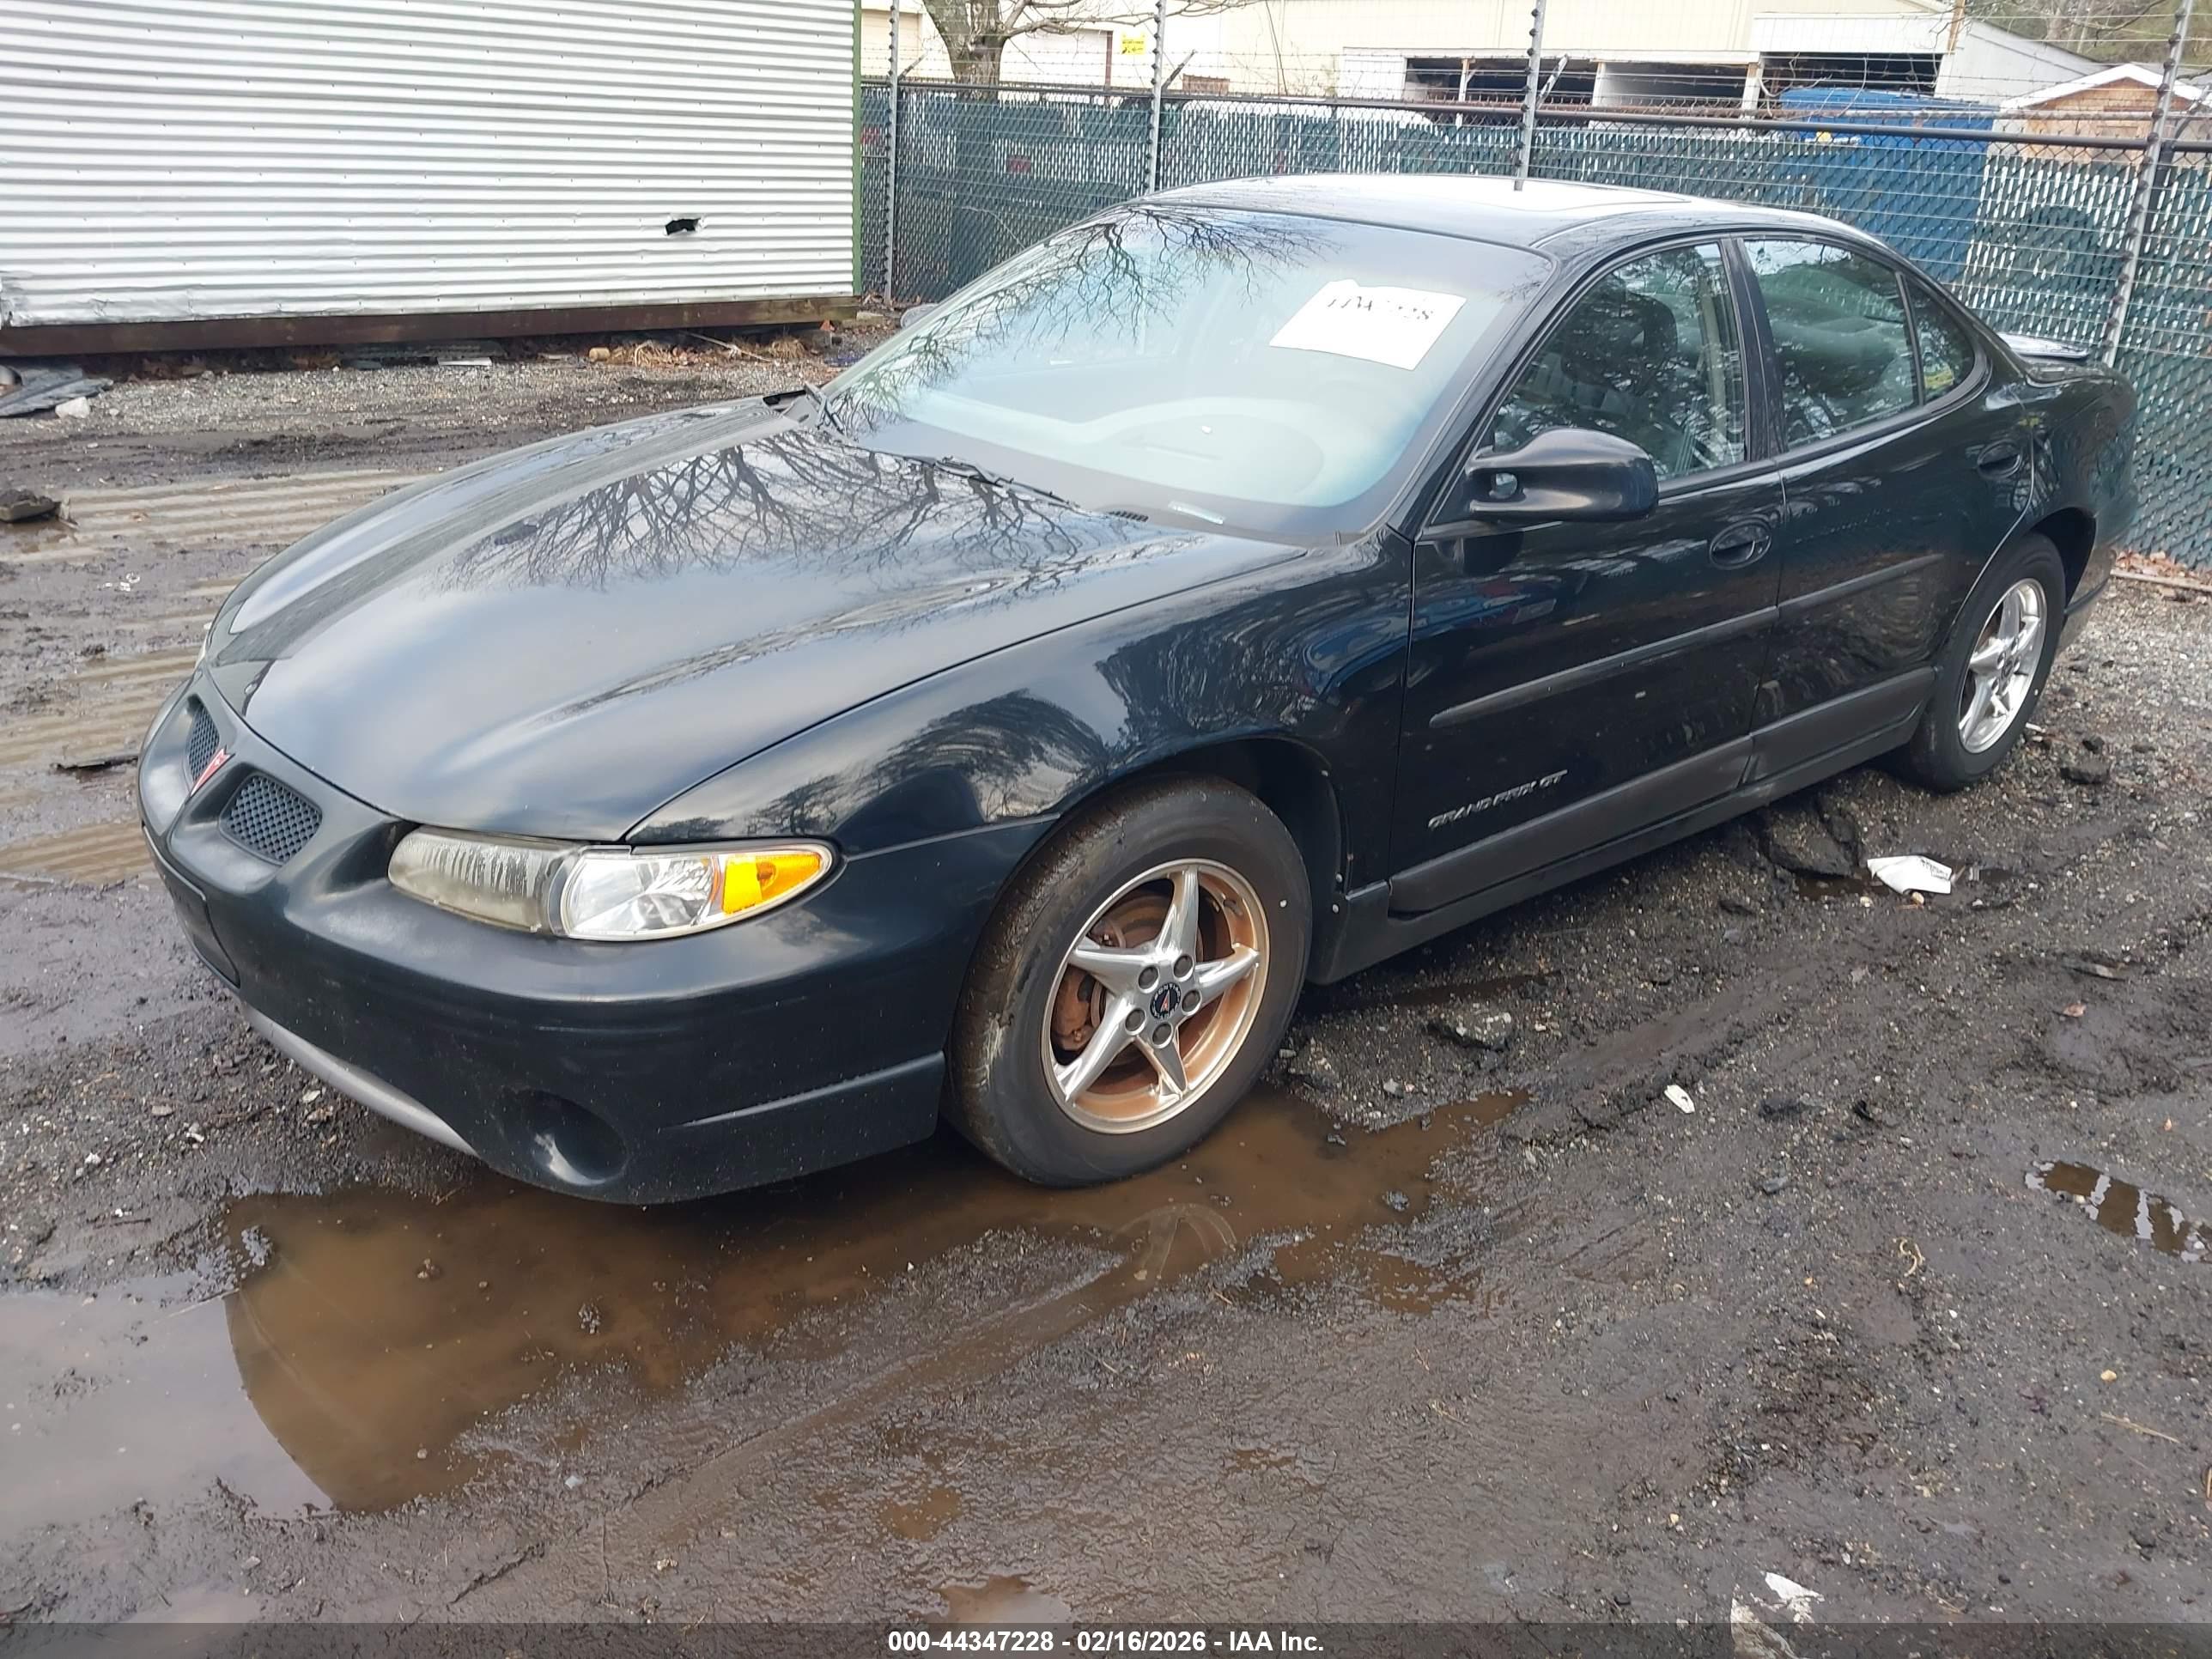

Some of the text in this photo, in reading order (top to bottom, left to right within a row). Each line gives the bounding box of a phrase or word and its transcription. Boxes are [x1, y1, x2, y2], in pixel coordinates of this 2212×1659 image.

[1428, 769, 1568, 830] GRAND PRIX GT
